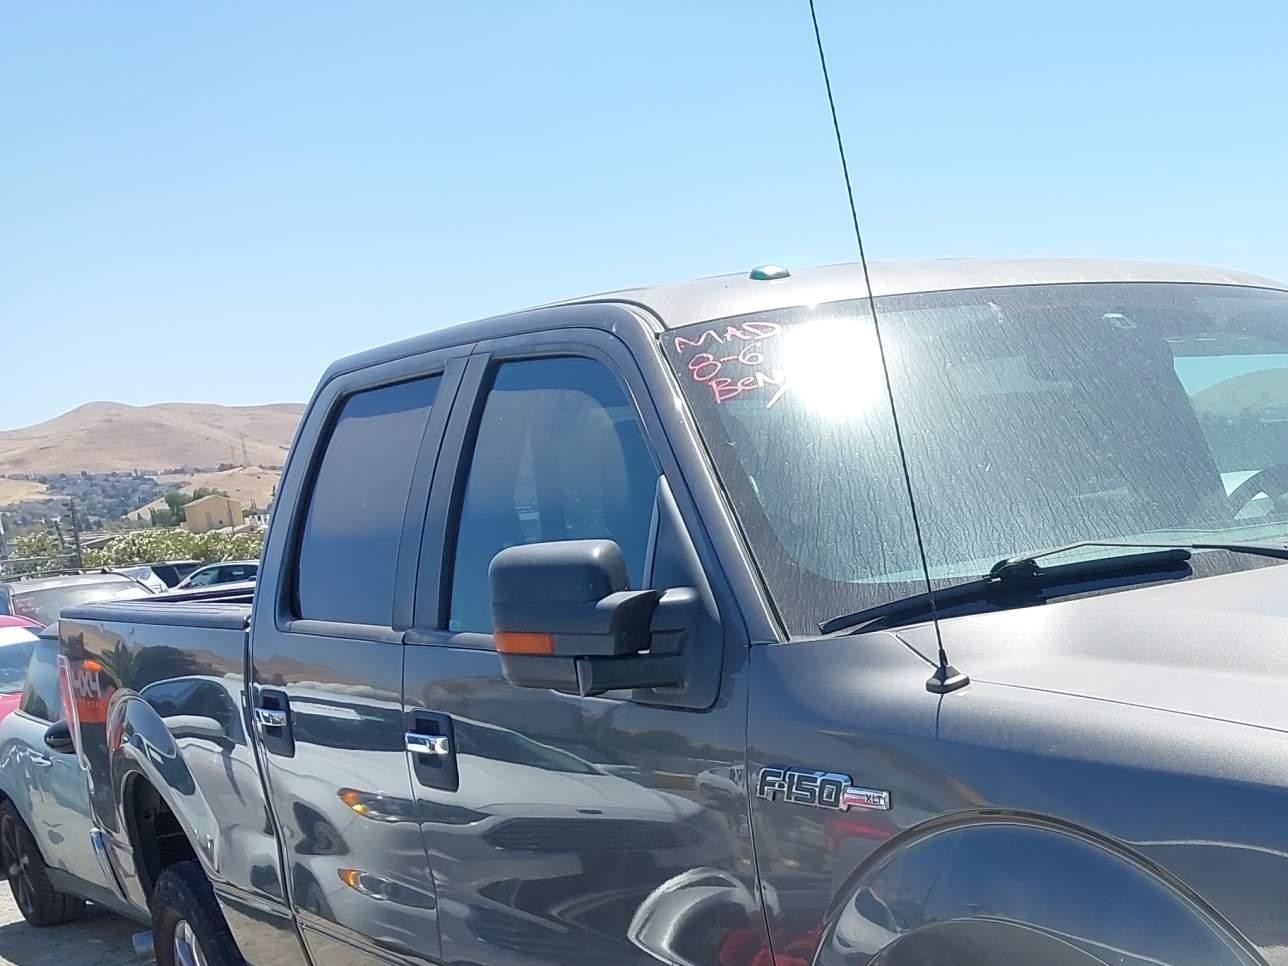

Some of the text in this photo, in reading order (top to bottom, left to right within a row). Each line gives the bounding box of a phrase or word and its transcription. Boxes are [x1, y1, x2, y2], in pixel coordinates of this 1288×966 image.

[673, 321, 782, 354] MAD
[688, 342, 764, 382] 8-6
[756, 767, 849, 811] F-150
